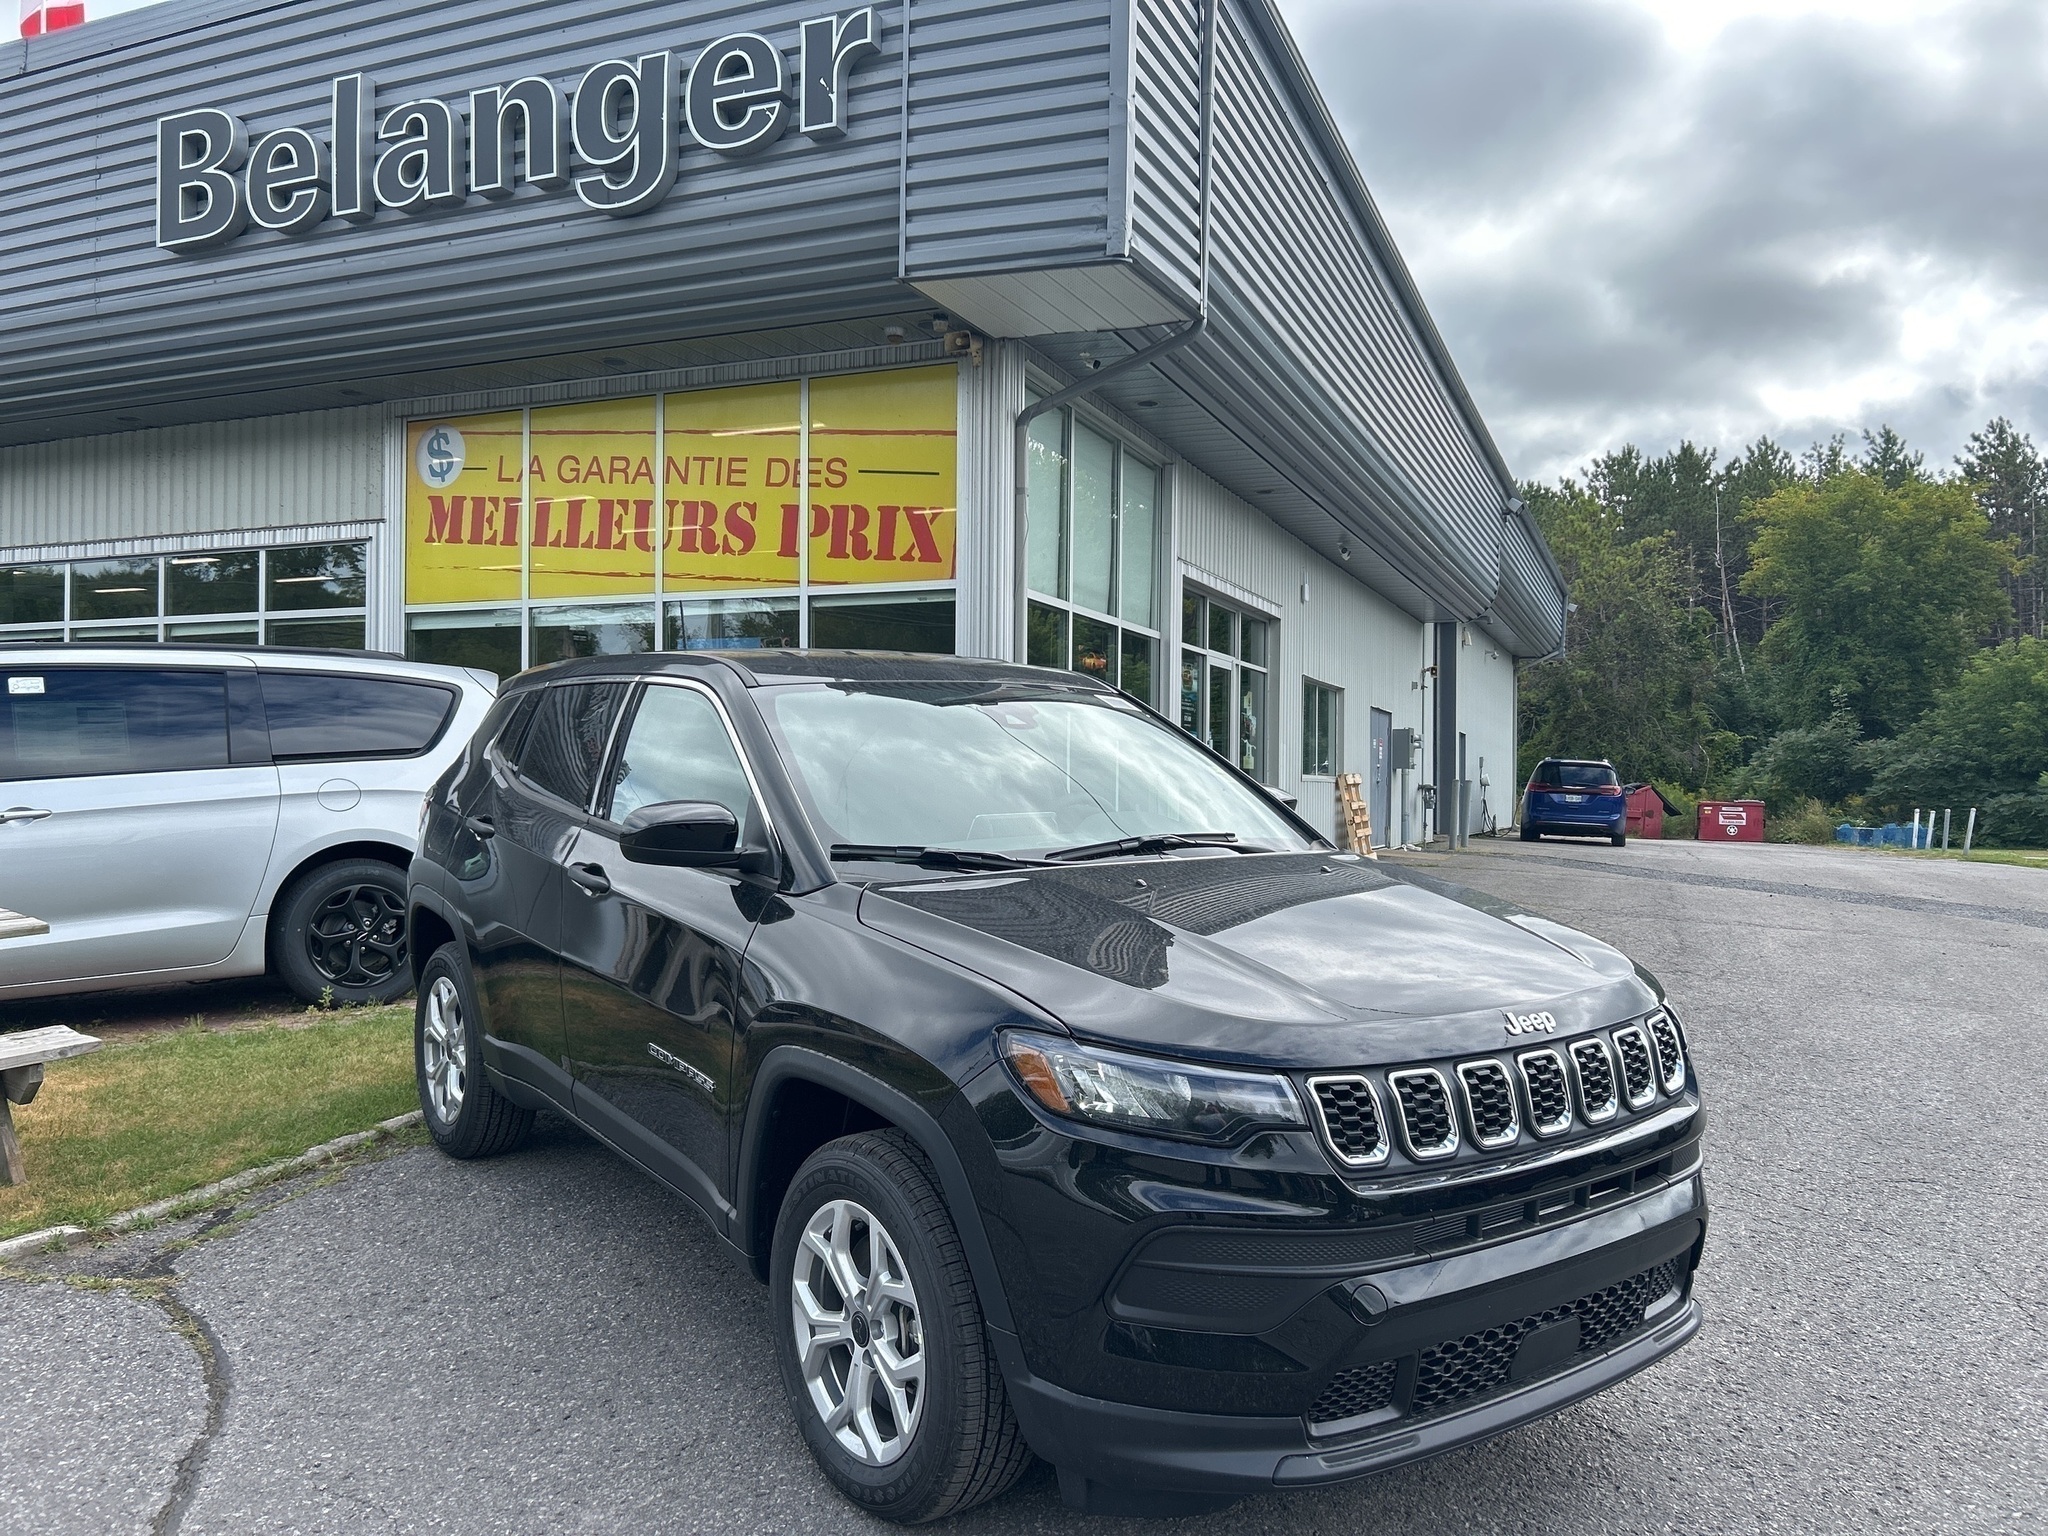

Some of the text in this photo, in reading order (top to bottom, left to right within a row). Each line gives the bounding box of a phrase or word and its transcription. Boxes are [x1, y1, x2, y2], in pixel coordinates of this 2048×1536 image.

[155, 6, 879, 253] Belanger
[427, 429, 454, 482] $
[497, 455, 848, 488] LA GARANTIE DES
[424, 495, 944, 564] MEILLEURS PRIX
[1504, 1011, 1557, 1036] Jeep
[647, 1042, 717, 1093] COMPASS
